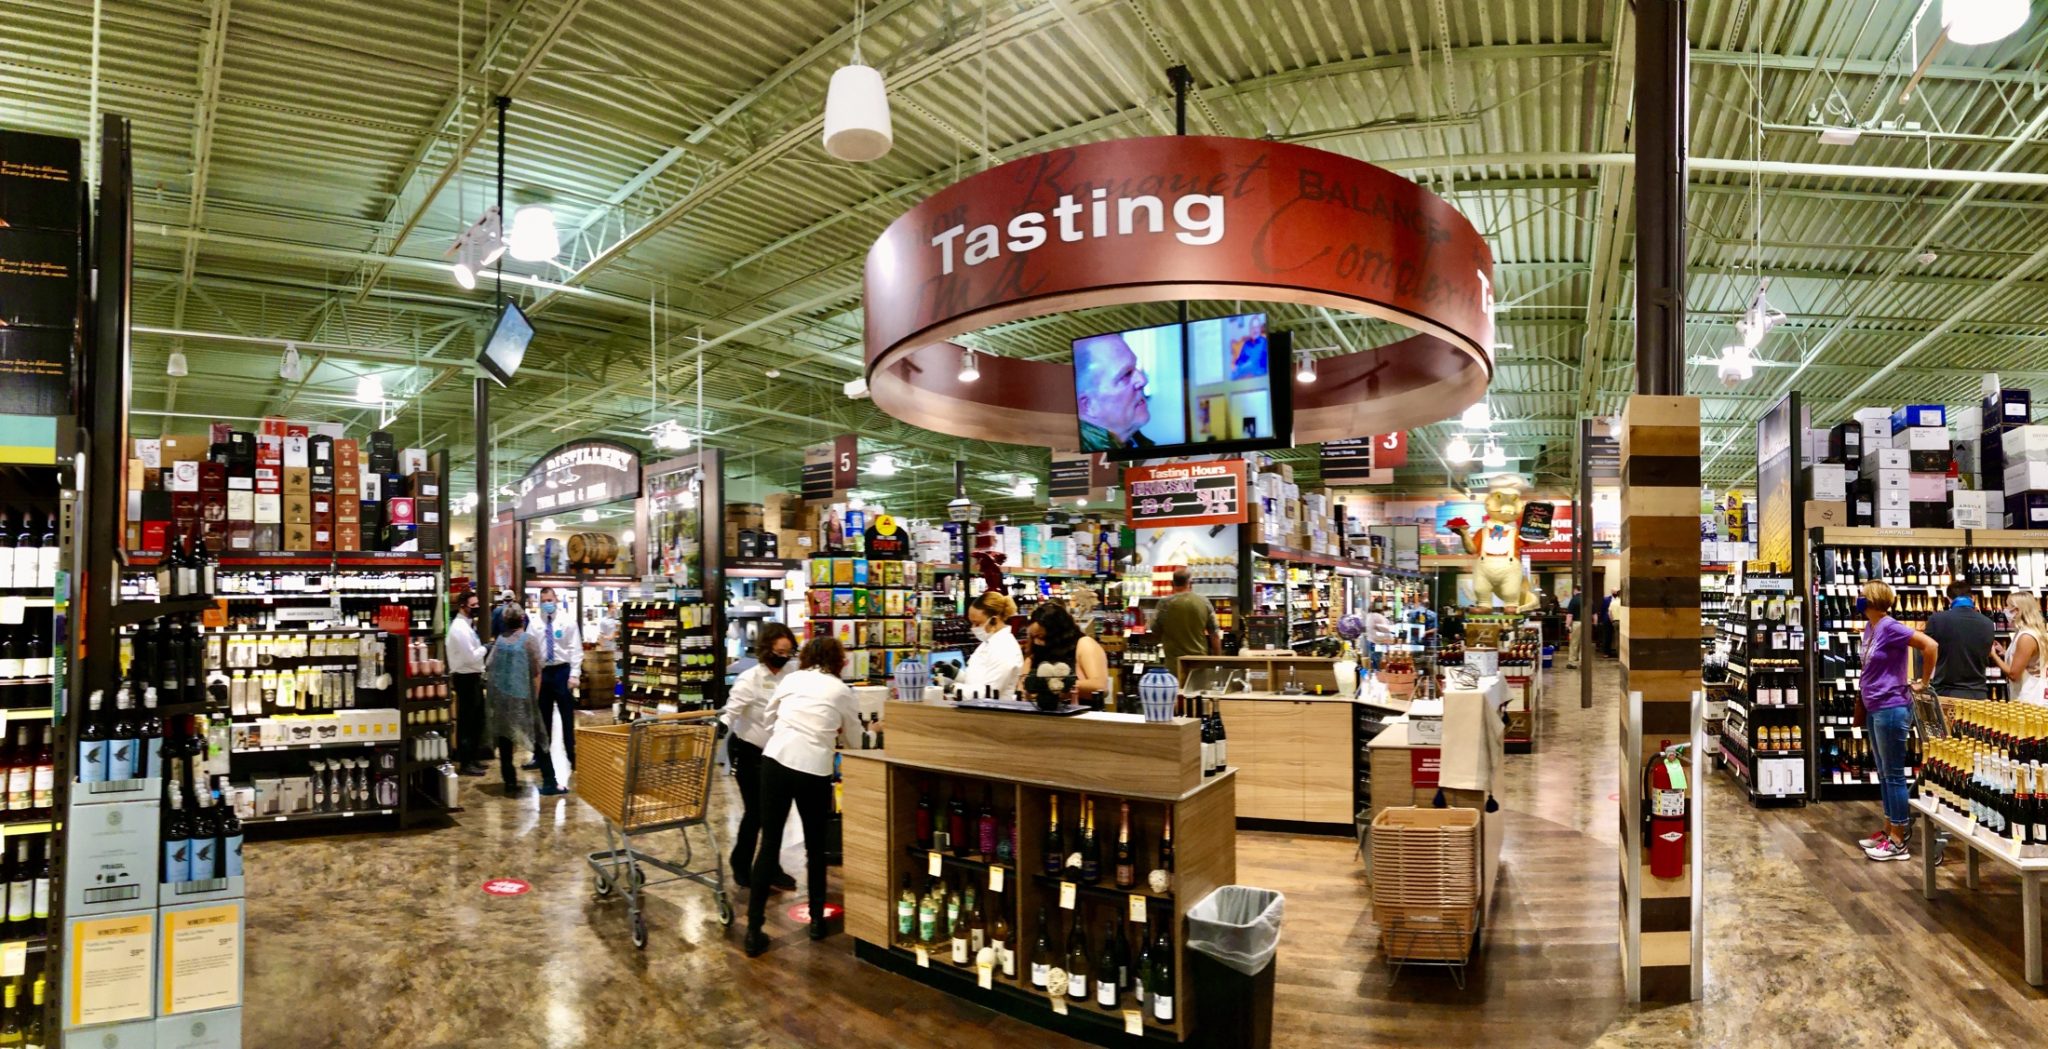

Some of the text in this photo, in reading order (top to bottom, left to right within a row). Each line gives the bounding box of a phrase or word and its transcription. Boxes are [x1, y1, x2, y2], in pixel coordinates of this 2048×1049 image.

[932, 188, 1225, 275] Tasting
[1383, 432, 1398, 450] 3
[841, 452, 851, 472] 5
[1099, 452, 1111, 470] 4
[1149, 465, 1226, 481] Tasting Hours
